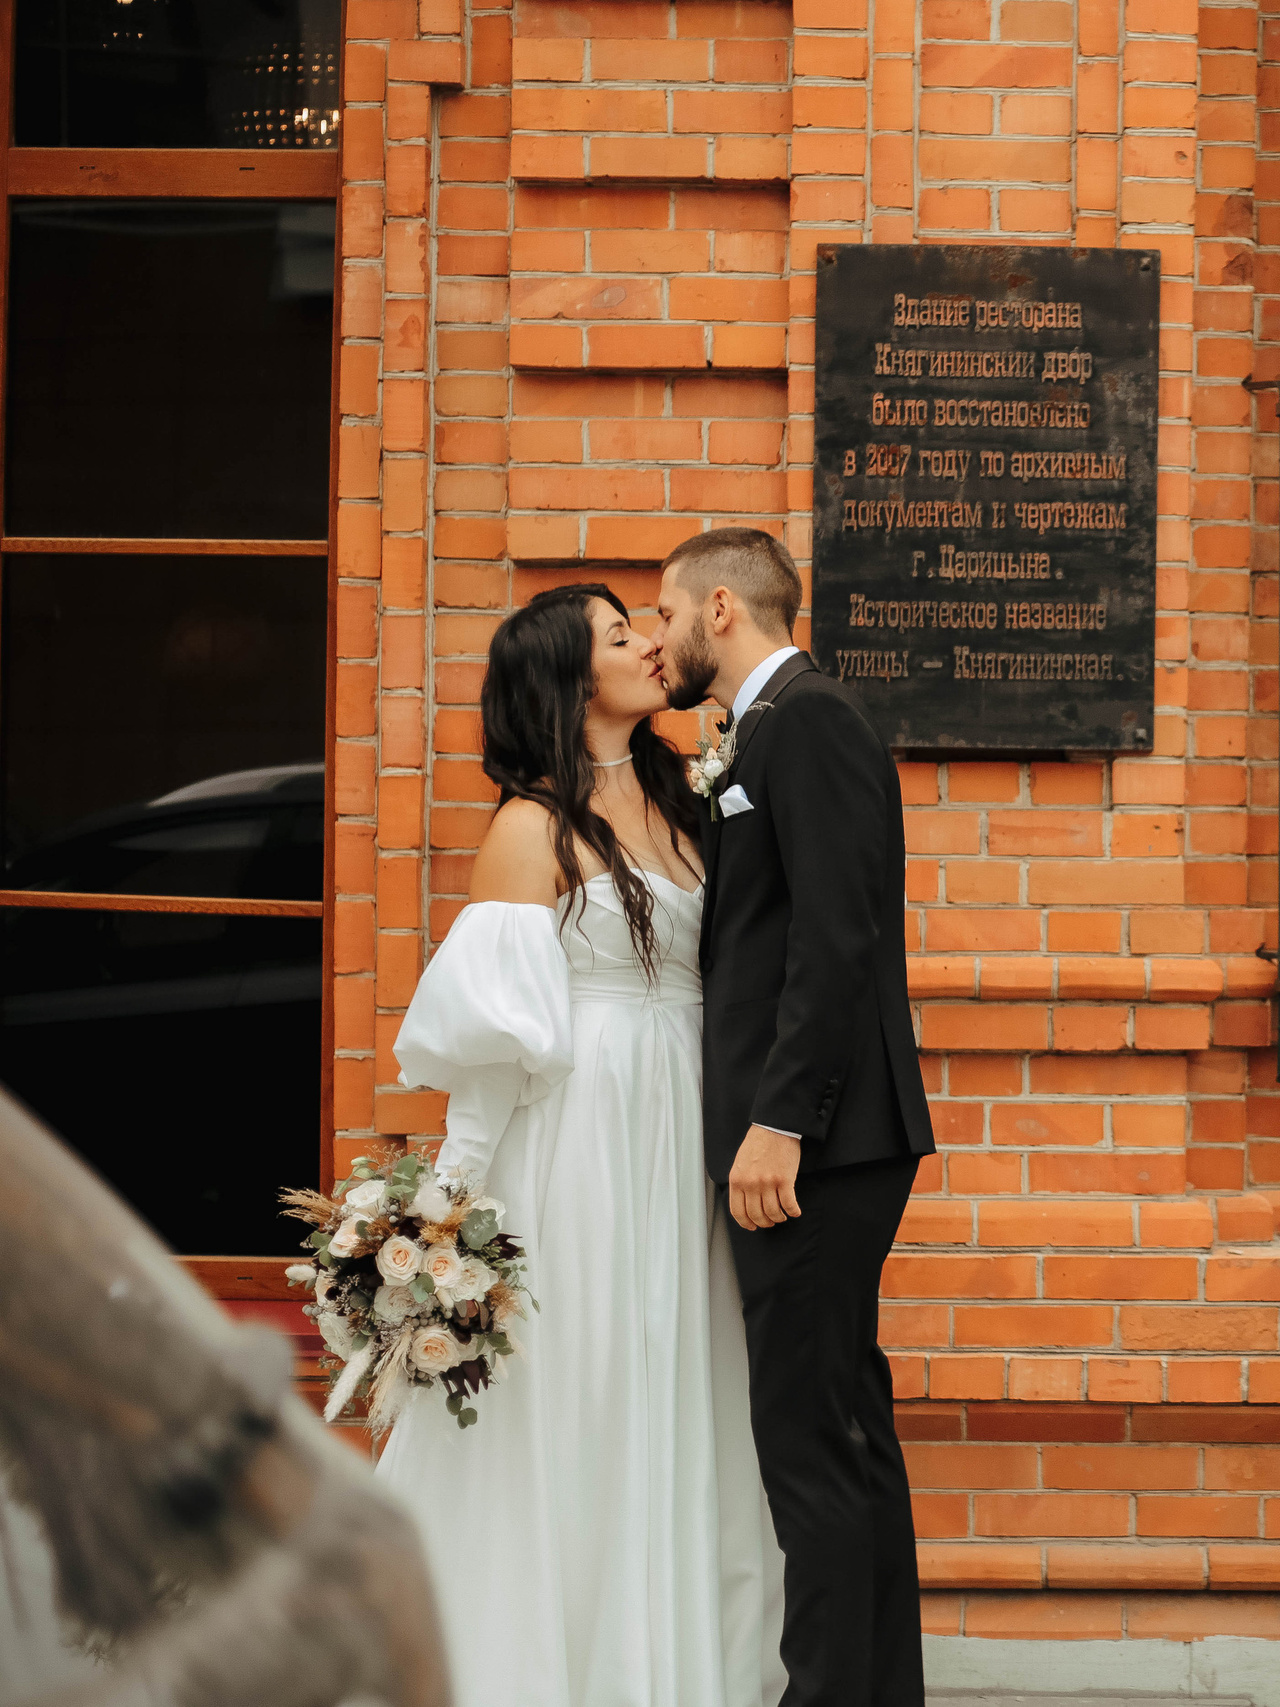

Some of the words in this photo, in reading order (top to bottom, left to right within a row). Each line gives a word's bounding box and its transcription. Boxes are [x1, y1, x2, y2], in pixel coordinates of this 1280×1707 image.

[893, 293, 970, 329] Здание
[974, 298, 1082, 333] ресторана
[1041, 346, 1093, 385] двор
[872, 392, 928, 427] было
[933, 398, 1091, 429] восстановлено
[843, 449, 856, 478] в
[865, 443, 912, 478] 2007
[918, 449, 972, 483] году
[979, 450, 1004, 478] по
[1010, 451, 1127, 483] архивным
[841, 499, 983, 533] документам
[991, 501, 1007, 528] и
[1014, 501, 1127, 534] чертежам
[849, 593, 997, 634] Историческое
[1005, 601, 1107, 630] название
[835, 649, 909, 682] улицы
